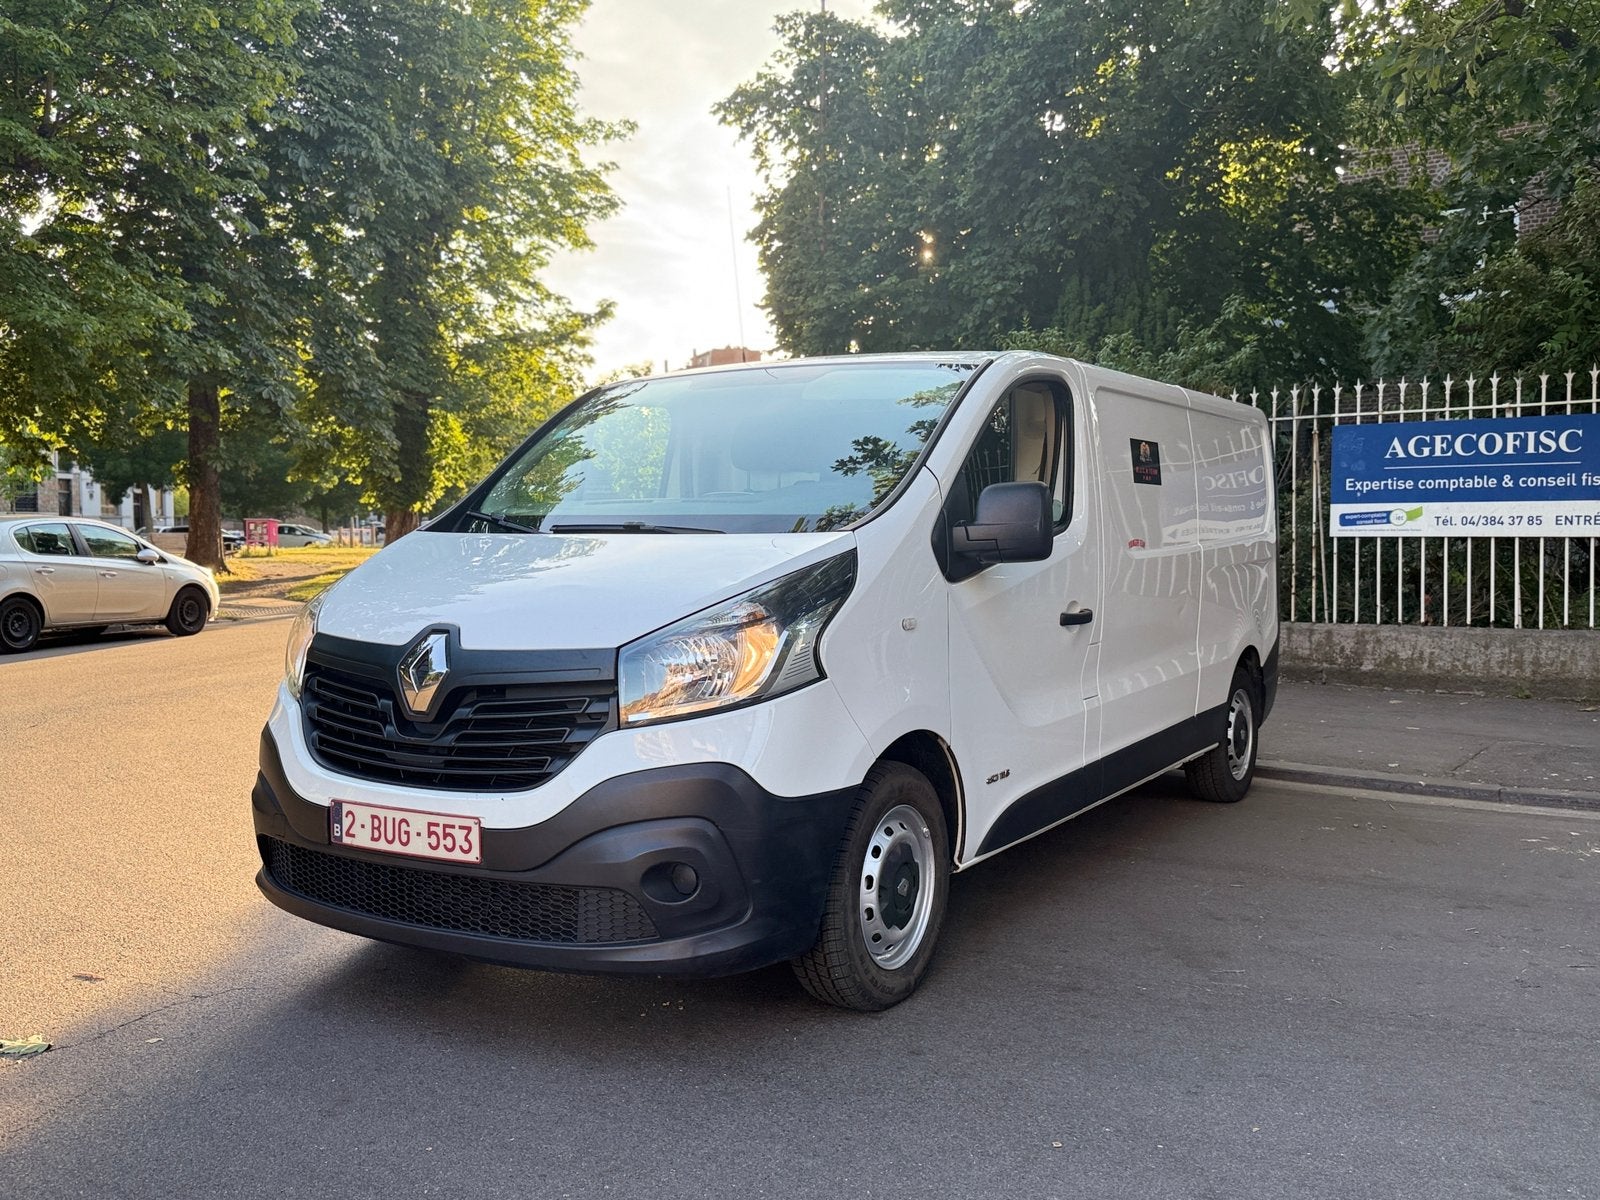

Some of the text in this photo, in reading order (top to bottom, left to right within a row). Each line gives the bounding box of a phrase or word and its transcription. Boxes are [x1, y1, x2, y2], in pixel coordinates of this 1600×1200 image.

[1384, 429, 1583, 459] AGECOFISC
[1345, 472, 1600, 493] Expertise comptable & conseil fis
[1434, 512, 1600, 527] Tél. 04/384 37 85 ENTRÉ
[333, 823, 341, 837] B
